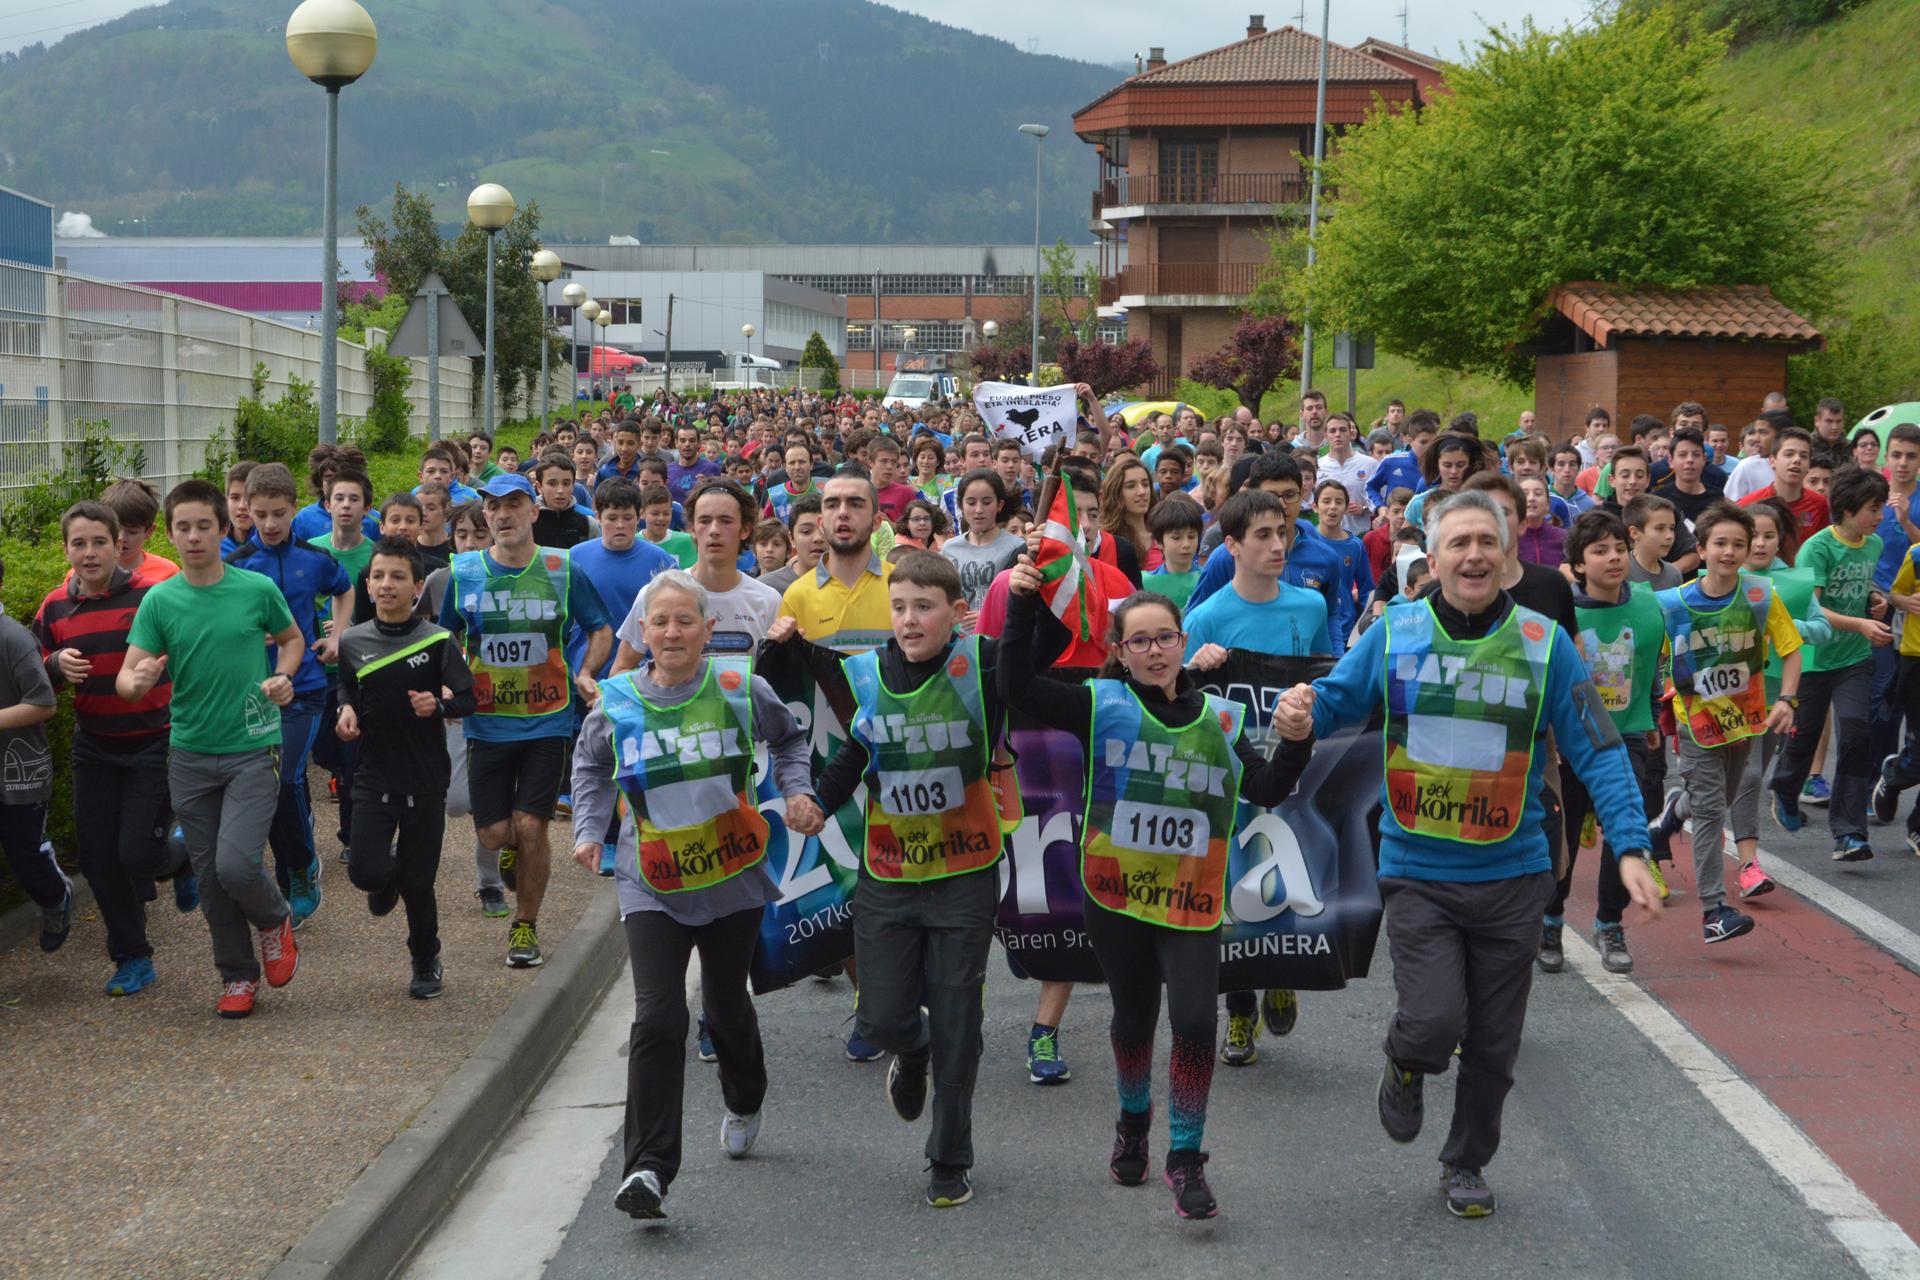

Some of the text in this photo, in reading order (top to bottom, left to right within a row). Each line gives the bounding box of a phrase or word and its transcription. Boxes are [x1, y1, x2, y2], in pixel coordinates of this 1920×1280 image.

[984, 399, 1003, 409] ETA
[487, 640, 532, 663] 1097
[498, 677, 517, 690] aek
[889, 781, 948, 814] 1103
[1426, 781, 1453, 800] aek
[907, 823, 928, 844] aek
[1129, 812, 1195, 849] 1103
[682, 837, 706, 857] aek
[1132, 866, 1161, 884] aek
[1219, 932, 1331, 963] IRUÑERA
